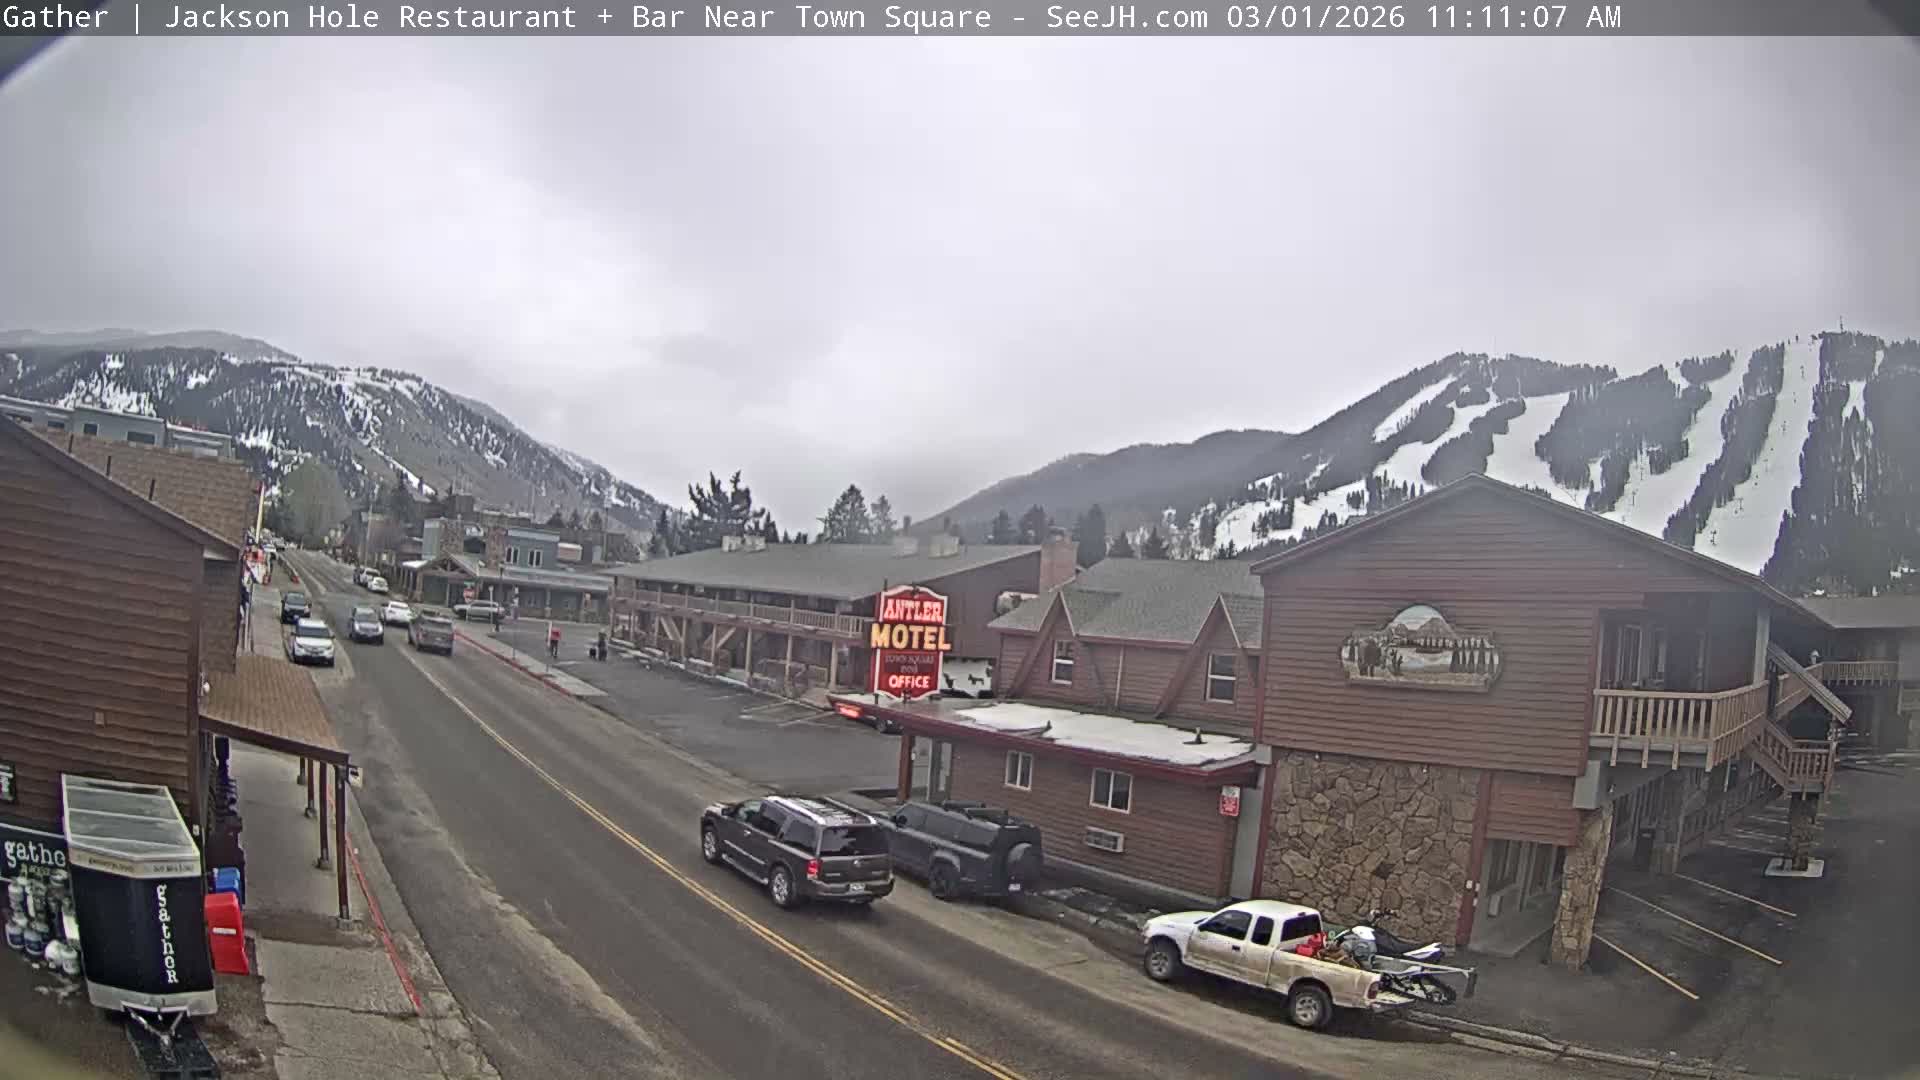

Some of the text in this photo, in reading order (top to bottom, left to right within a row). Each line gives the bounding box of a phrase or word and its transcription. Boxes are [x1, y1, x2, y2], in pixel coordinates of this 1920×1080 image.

[883, 598, 943, 622] ANTLER
[870, 622, 952, 650] MOTEL
[888, 674, 931, 689] OFFICE
